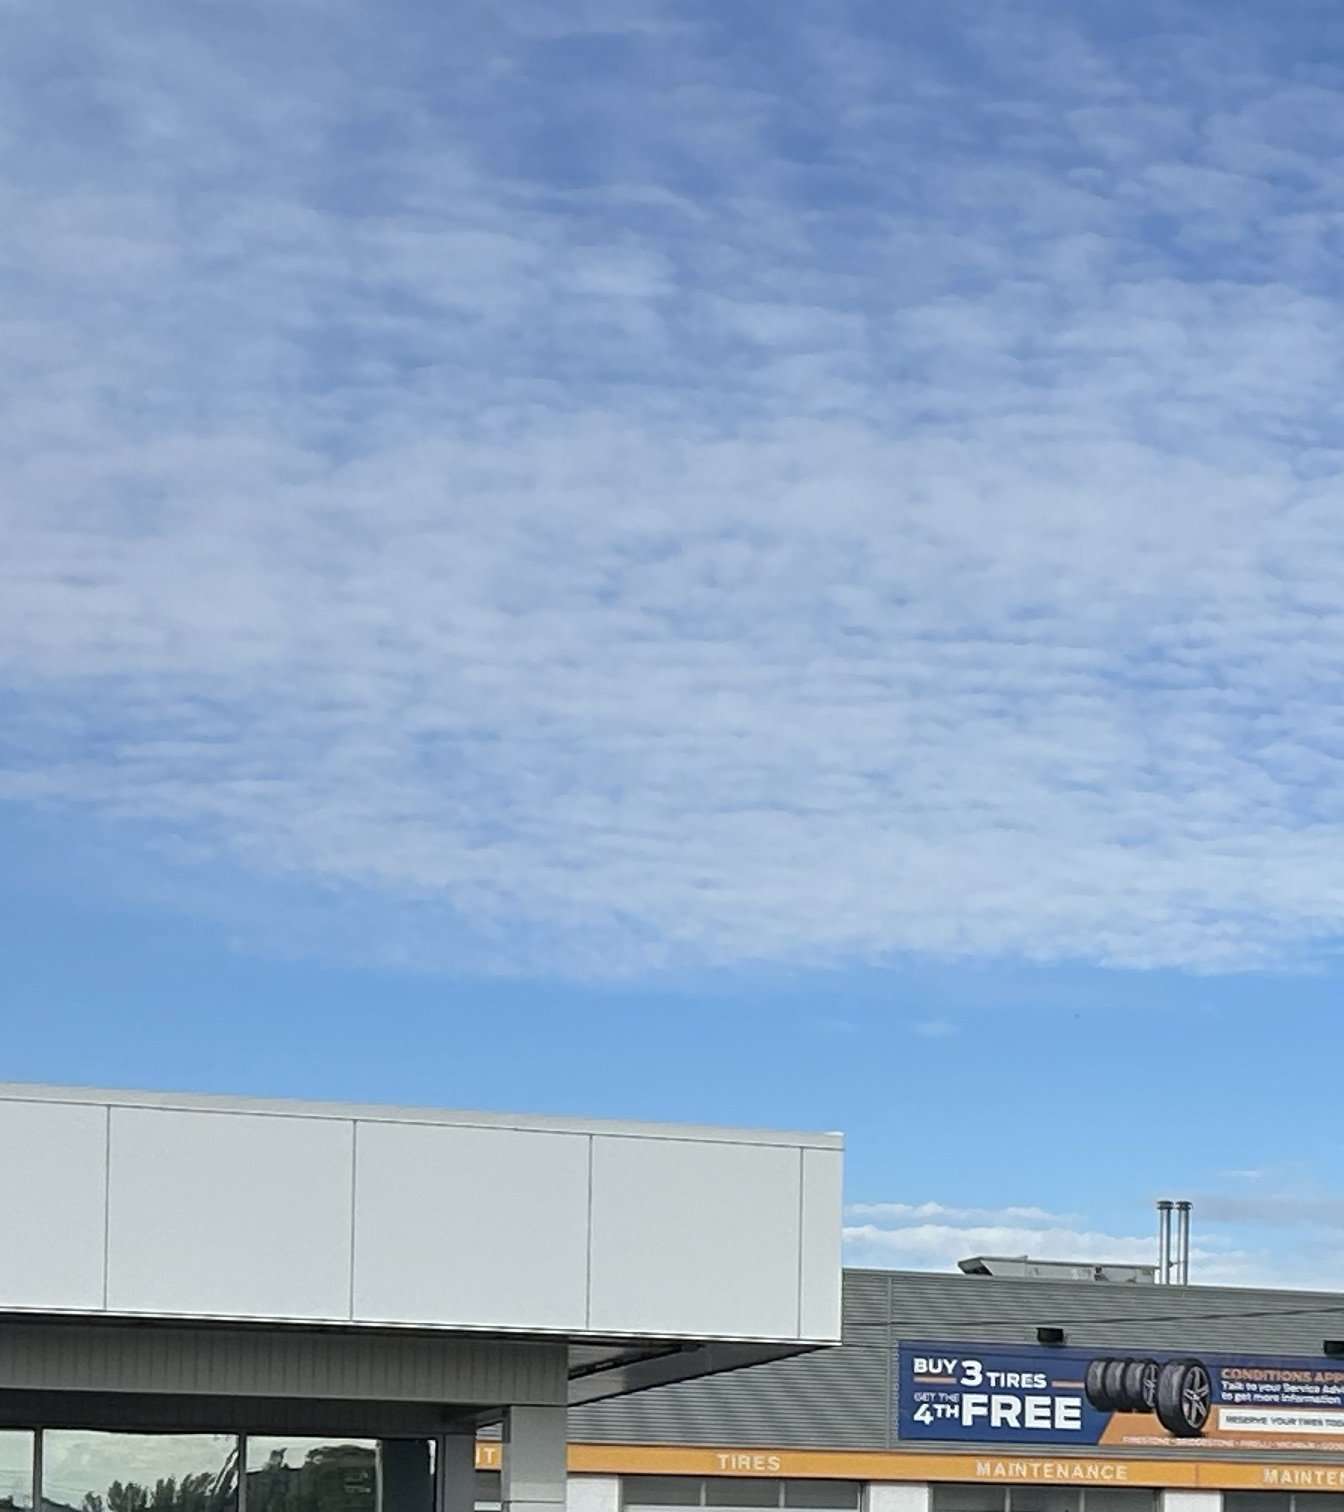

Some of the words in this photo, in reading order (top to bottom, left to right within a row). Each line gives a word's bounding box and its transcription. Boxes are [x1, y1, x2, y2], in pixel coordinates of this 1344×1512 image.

[913, 1358, 958, 1374] BUY
[960, 1360, 983, 1387] 3
[986, 1372, 1047, 1388] TIRES
[1221, 1369, 1312, 1382] CONDITIONS
[914, 1392, 936, 1402] GET
[938, 1393, 960, 1403] THE
[913, 1403, 960, 1425] 4TH
[962, 1394, 1082, 1430] FREE
[717, 1453, 781, 1470] TIRES
[975, 1460, 1128, 1481] MAINTENANCE
